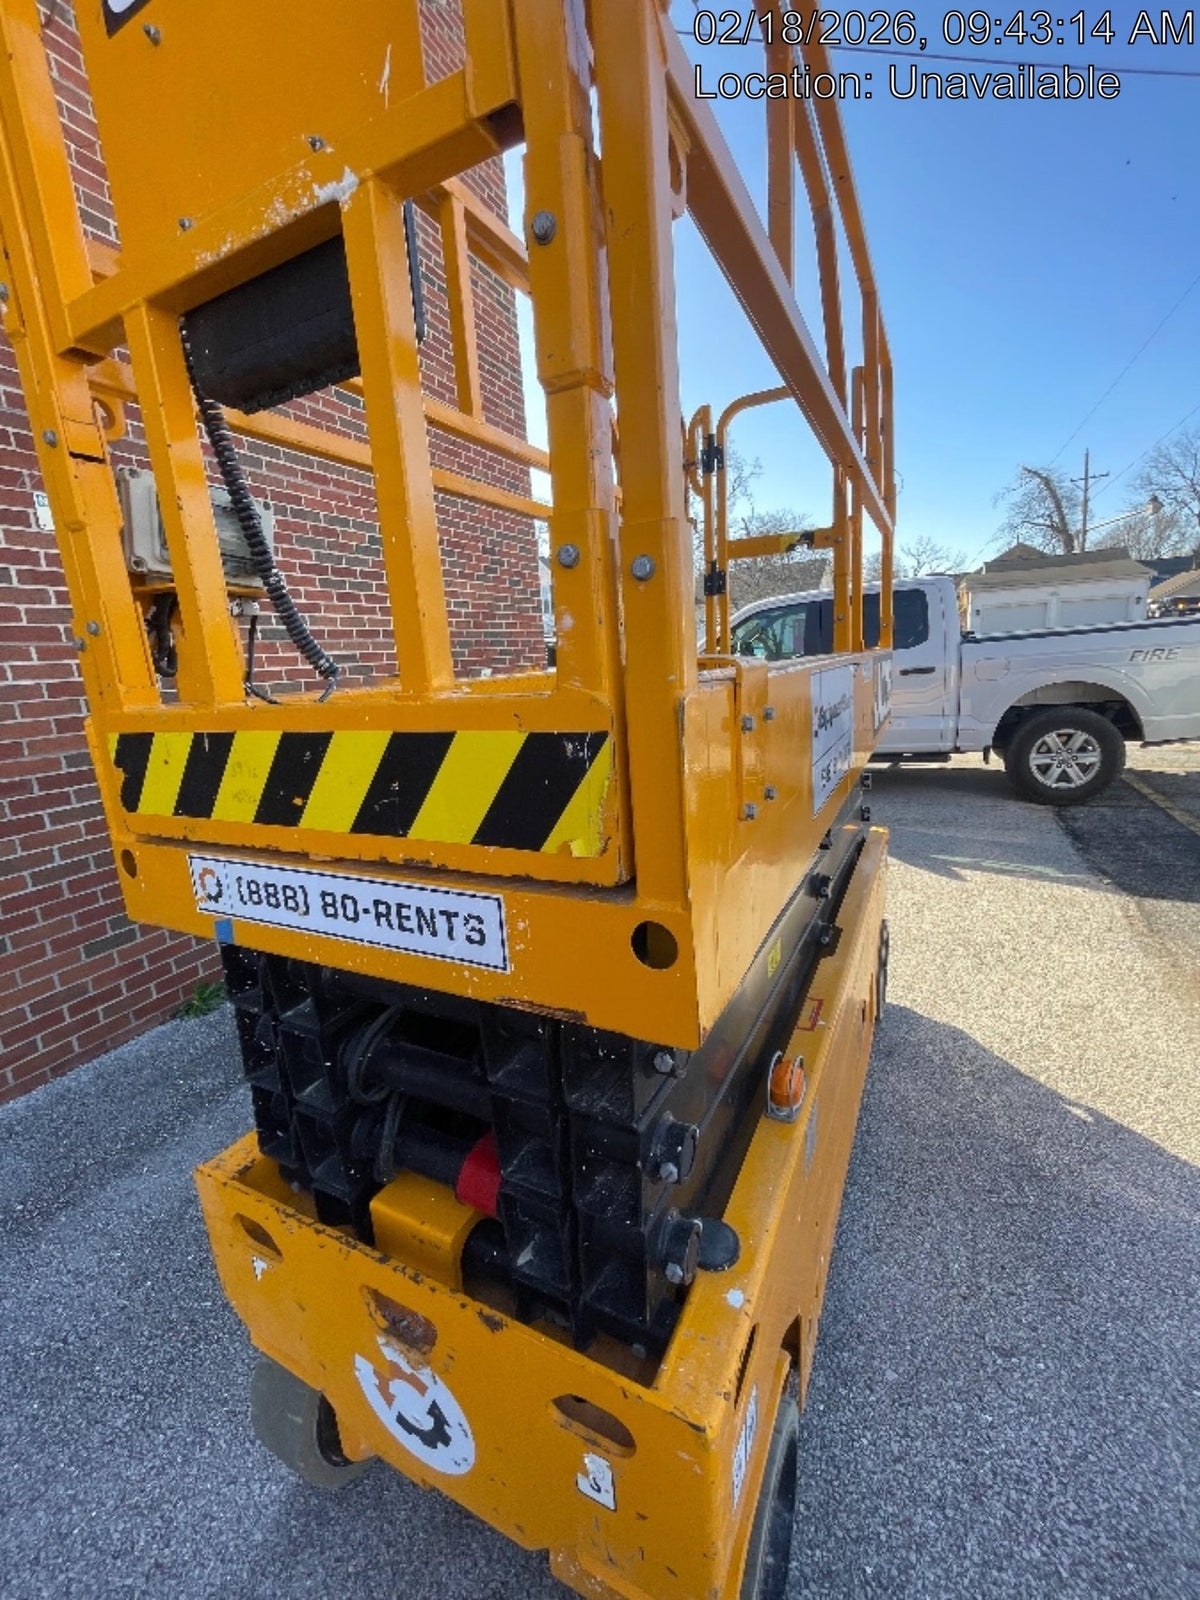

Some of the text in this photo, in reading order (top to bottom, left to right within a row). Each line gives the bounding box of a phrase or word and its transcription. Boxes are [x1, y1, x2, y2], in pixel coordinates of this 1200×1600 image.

[1128, 646, 1181, 663] FIRE
[235, 875, 487, 947] (888) 80-RENTS
